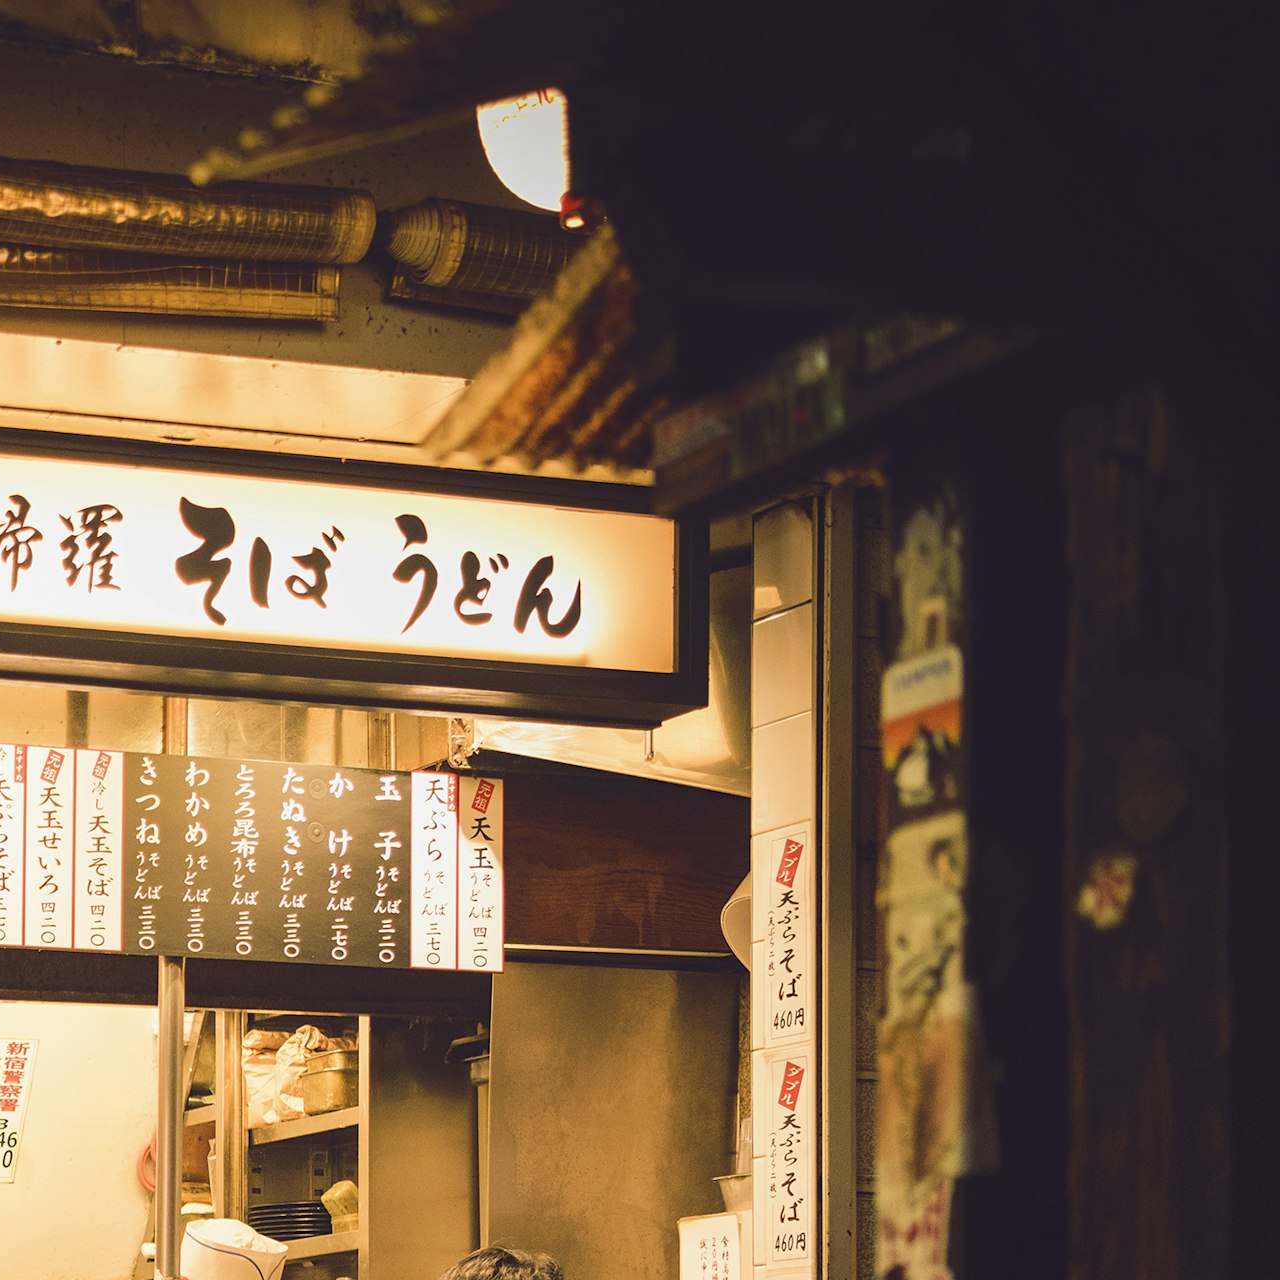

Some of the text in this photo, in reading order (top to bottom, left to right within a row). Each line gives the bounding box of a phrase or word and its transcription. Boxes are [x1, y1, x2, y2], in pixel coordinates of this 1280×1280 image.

[175, 496, 346, 627] そば
[391, 513, 582, 640] うどん
[41, 752, 63, 784] 元祖
[93, 754, 110, 780] 元祖
[474, 783, 491, 810] 元祖
[36, 786, 64, 944] 天玉せいろ 四二〇
[86, 781, 114, 947] 冷し天玉そば 四二〇
[134, 756, 162, 950] きつね そば うどん 三三〇
[182, 761, 211, 953] わかめ そば うどん 三三〇
[230, 764, 260, 955] とろろ昆布 そば うどん 三三〇
[279, 767, 308, 958] たぬき そば うどん 三三〇
[326, 772, 355, 961] かけ そば うどん 二七〇
[374, 775, 402, 963] 玉子 そば うどん 三二〇
[421, 779, 448, 965] 天ぷら そば うどん 三七〇
[468, 817, 494, 967] 天玉 そば うどん 四二〇
[779, 843, 802, 883] ダブル
[773, 889, 805, 1030] 天ぷらそば 460円
[781, 1067, 803, 1105] ダブル
[775, 1113, 806, 1253] 天ぷらそば 460円
